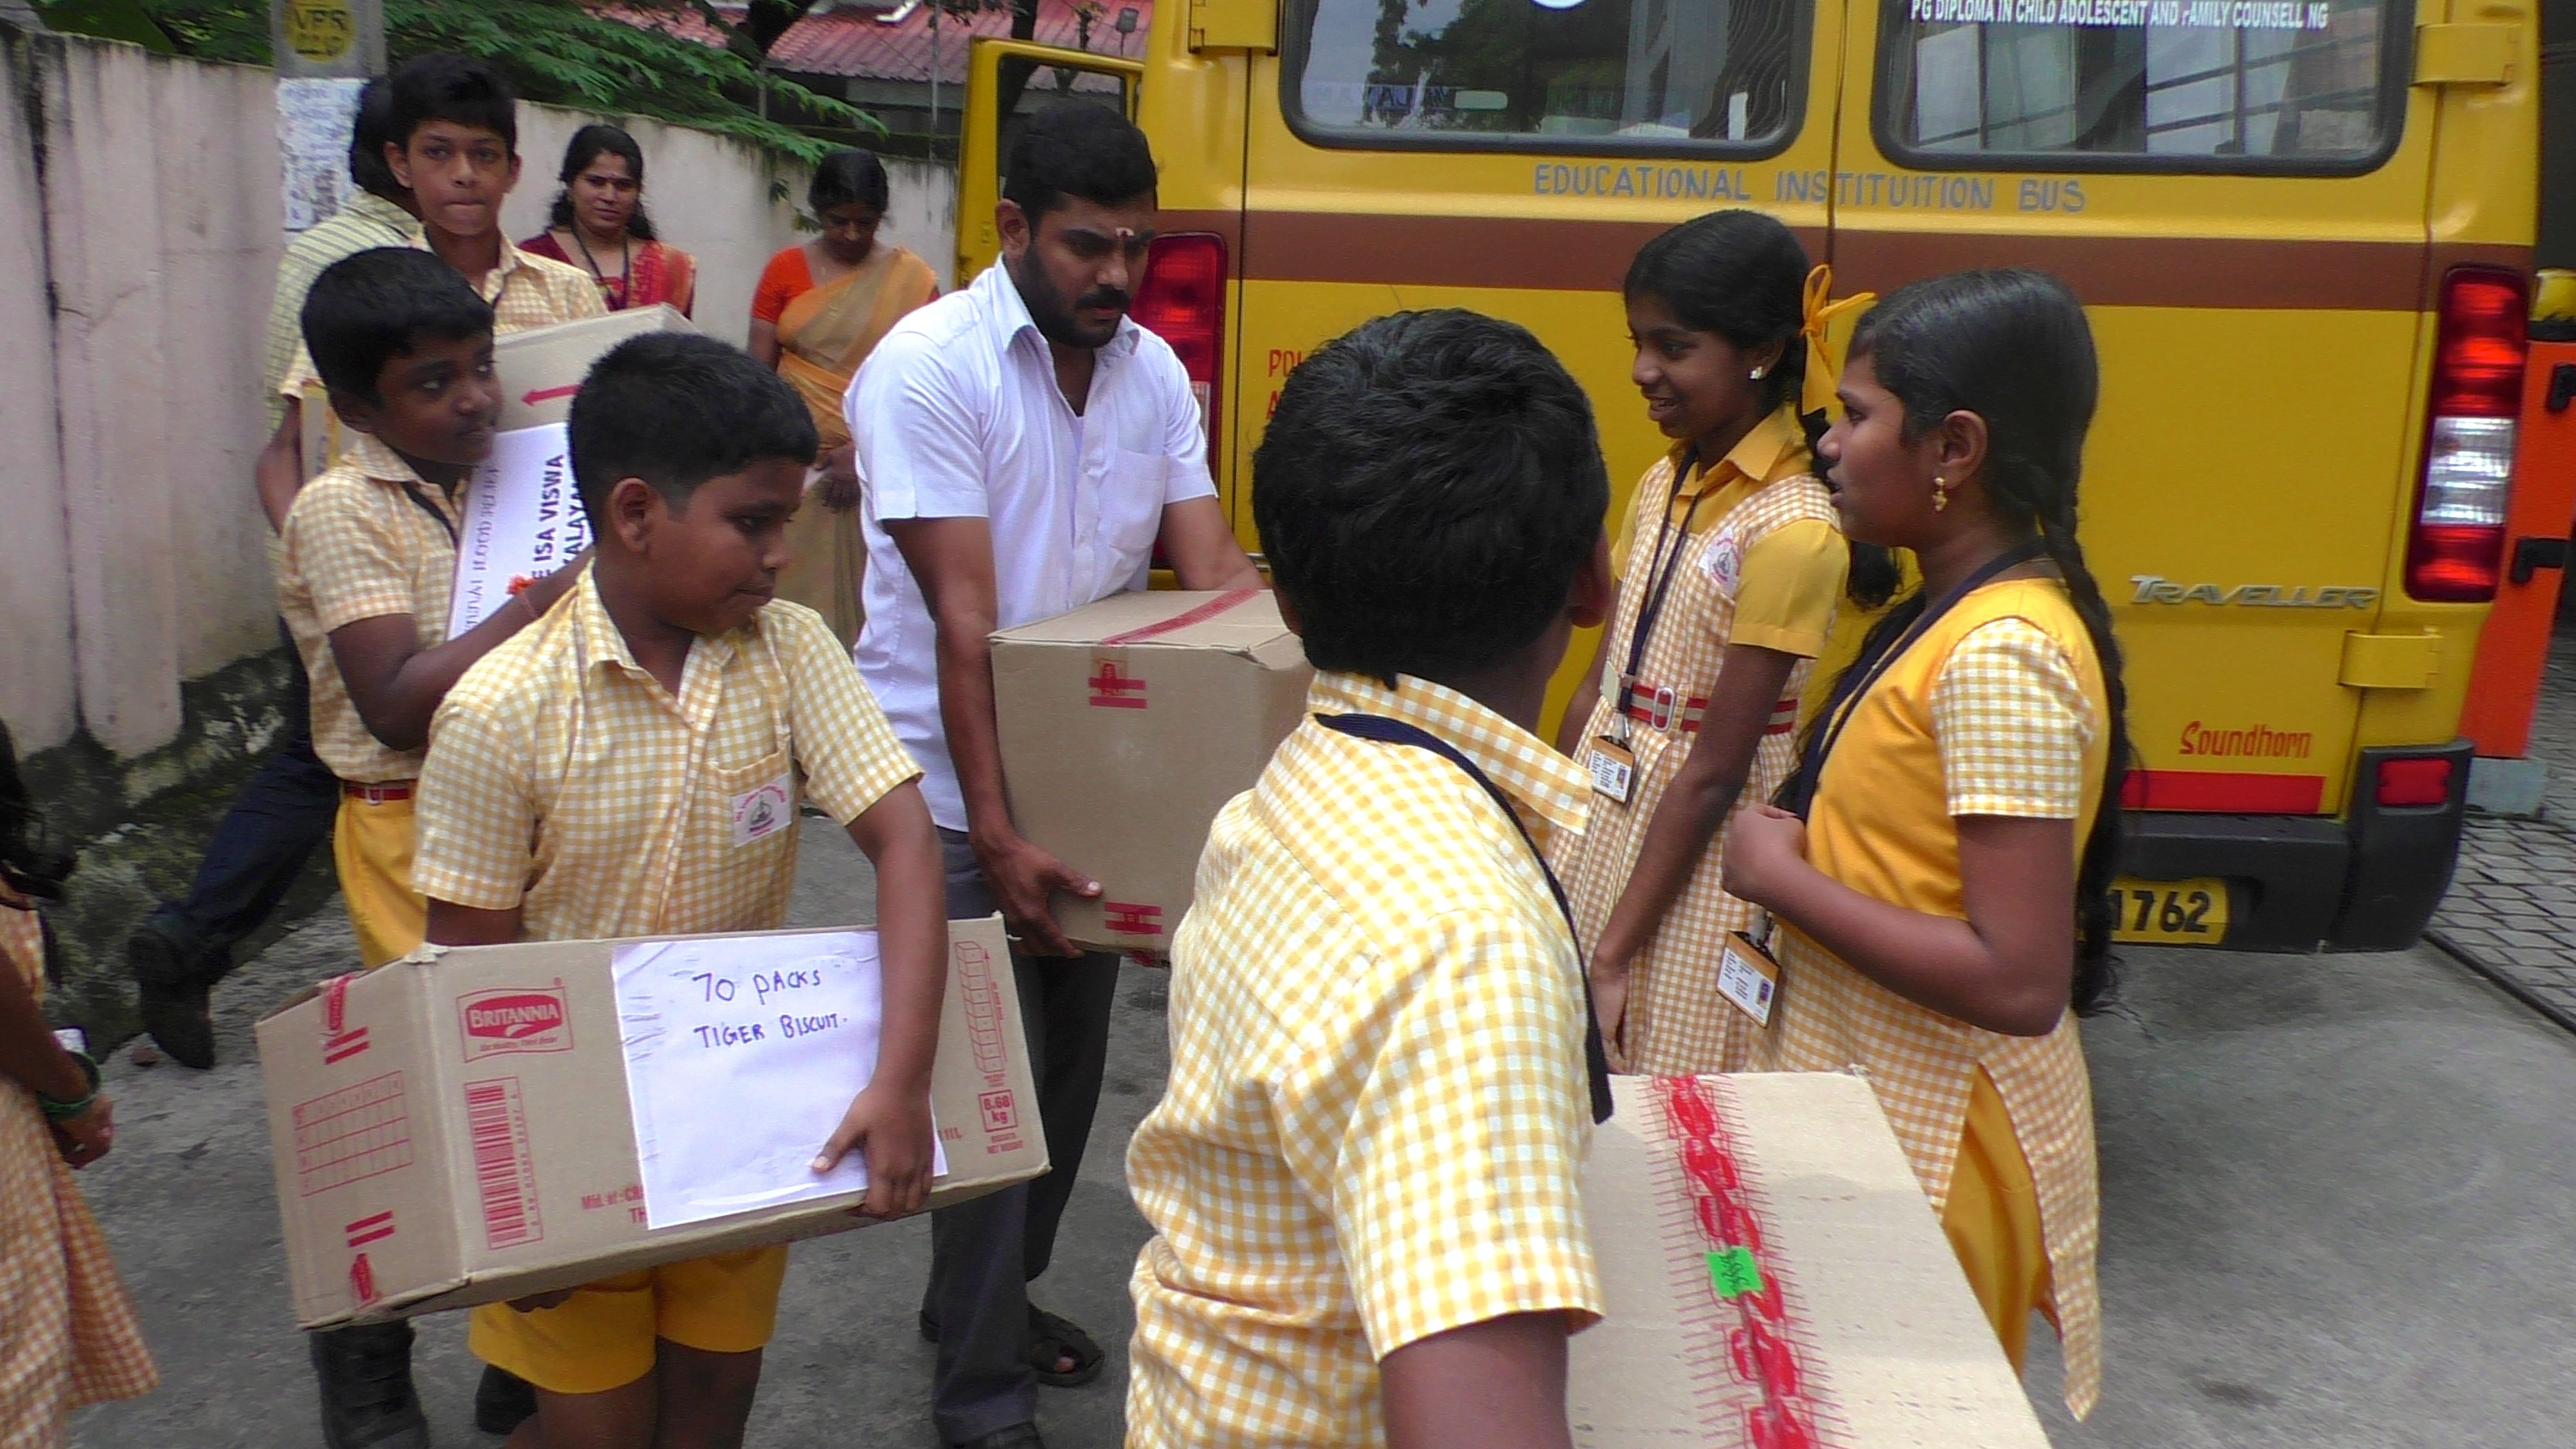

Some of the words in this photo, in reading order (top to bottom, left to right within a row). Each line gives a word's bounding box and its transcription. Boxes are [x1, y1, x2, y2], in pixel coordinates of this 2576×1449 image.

[1910, 0, 1931, 20] PG
[1935, 0, 1995, 22] DIPLOMA
[1997, 0, 2012, 22] IN
[2015, 0, 2055, 23] CHILD
[2058, 0, 2148, 26] ADOLESCENT
[2149, 1, 2178, 26] AND
[1534, 163, 1751, 201] EDUCATIONAL
[1775, 169, 1995, 209] INSTITUITION
[2017, 178, 2085, 214] BUS
[538, 454, 564, 522] VISWA
[532, 527, 557, 562] ISA
[2129, 574, 2380, 609] TRAVELLER
[2178, 720, 2313, 759] Soundhorn
[2108, 889, 2213, 933] 1762
[692, 971, 735, 1002] 70
[469, 1002, 560, 1028] BRITANNIA
[693, 1023, 765, 1048] TIGER
[990, 1110, 1008, 1124] kg
